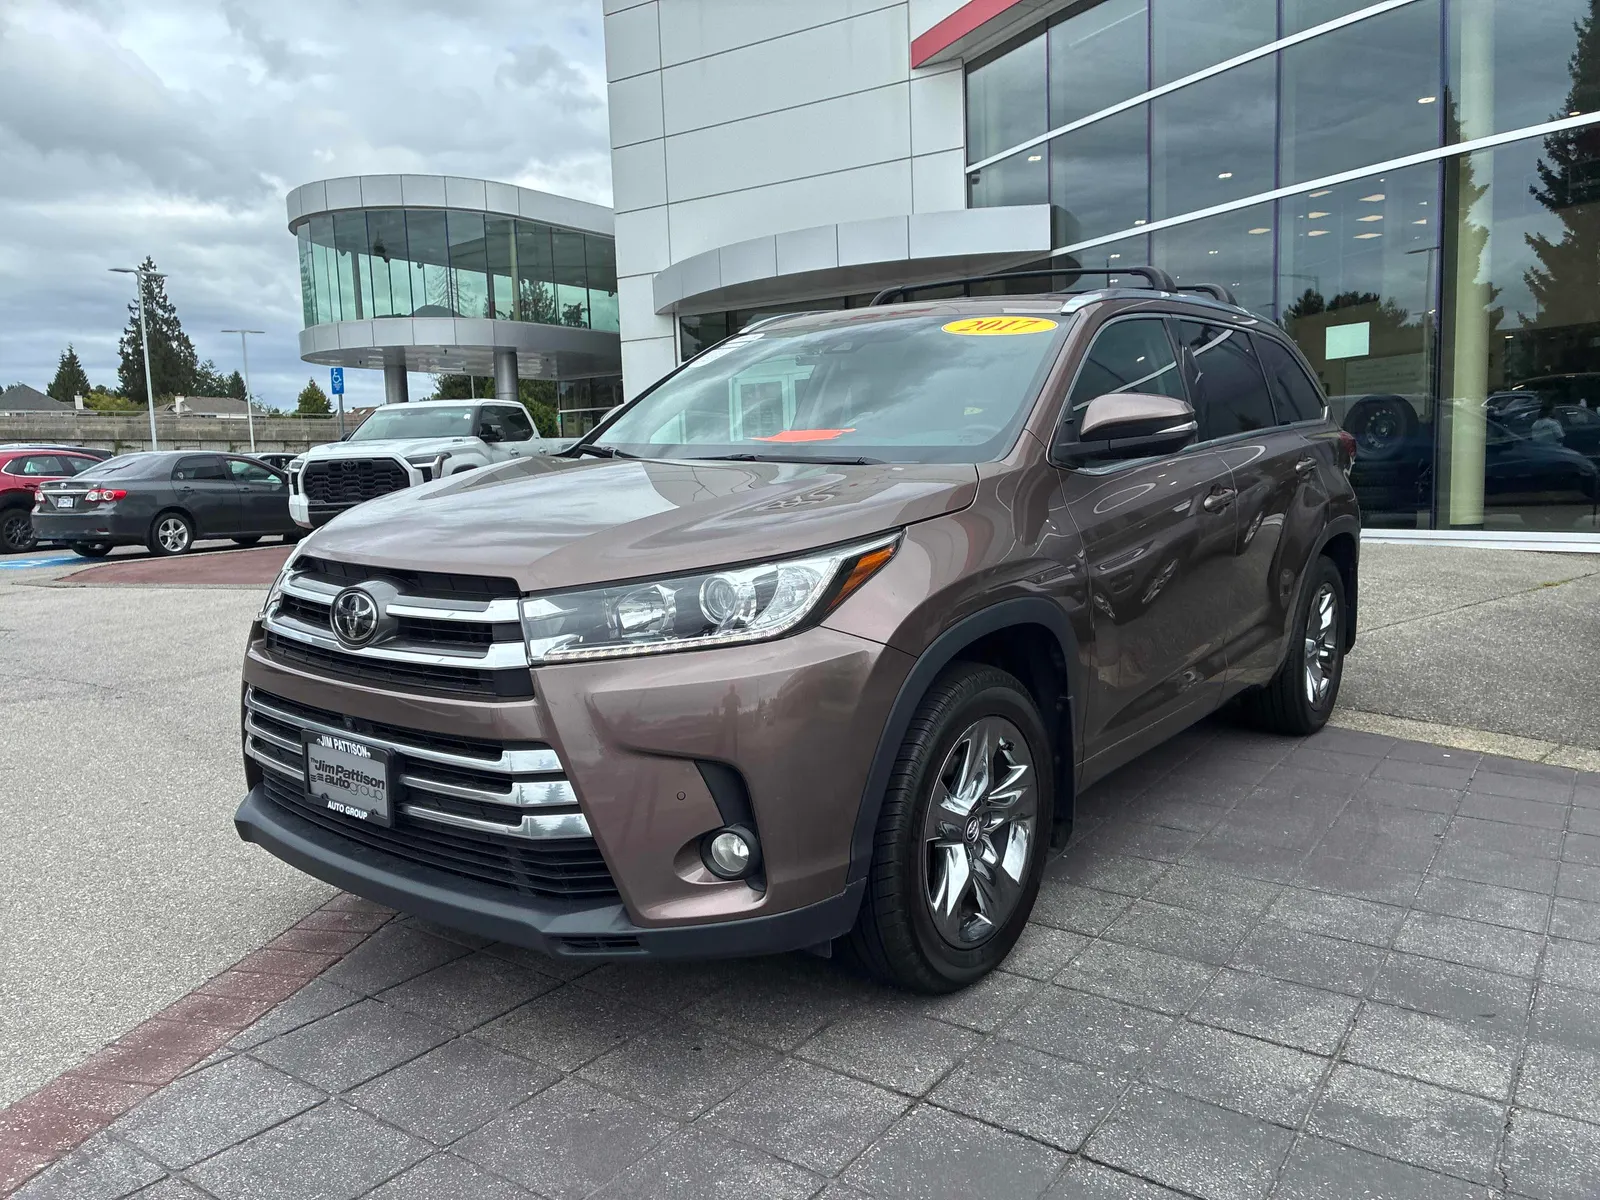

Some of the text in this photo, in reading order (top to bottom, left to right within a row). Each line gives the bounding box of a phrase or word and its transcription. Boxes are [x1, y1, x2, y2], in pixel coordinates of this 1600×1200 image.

[956, 320, 1041, 331] 2017
[321, 735, 368, 758] JIM PATTISON
[327, 800, 368, 820] AUTO GROUP
